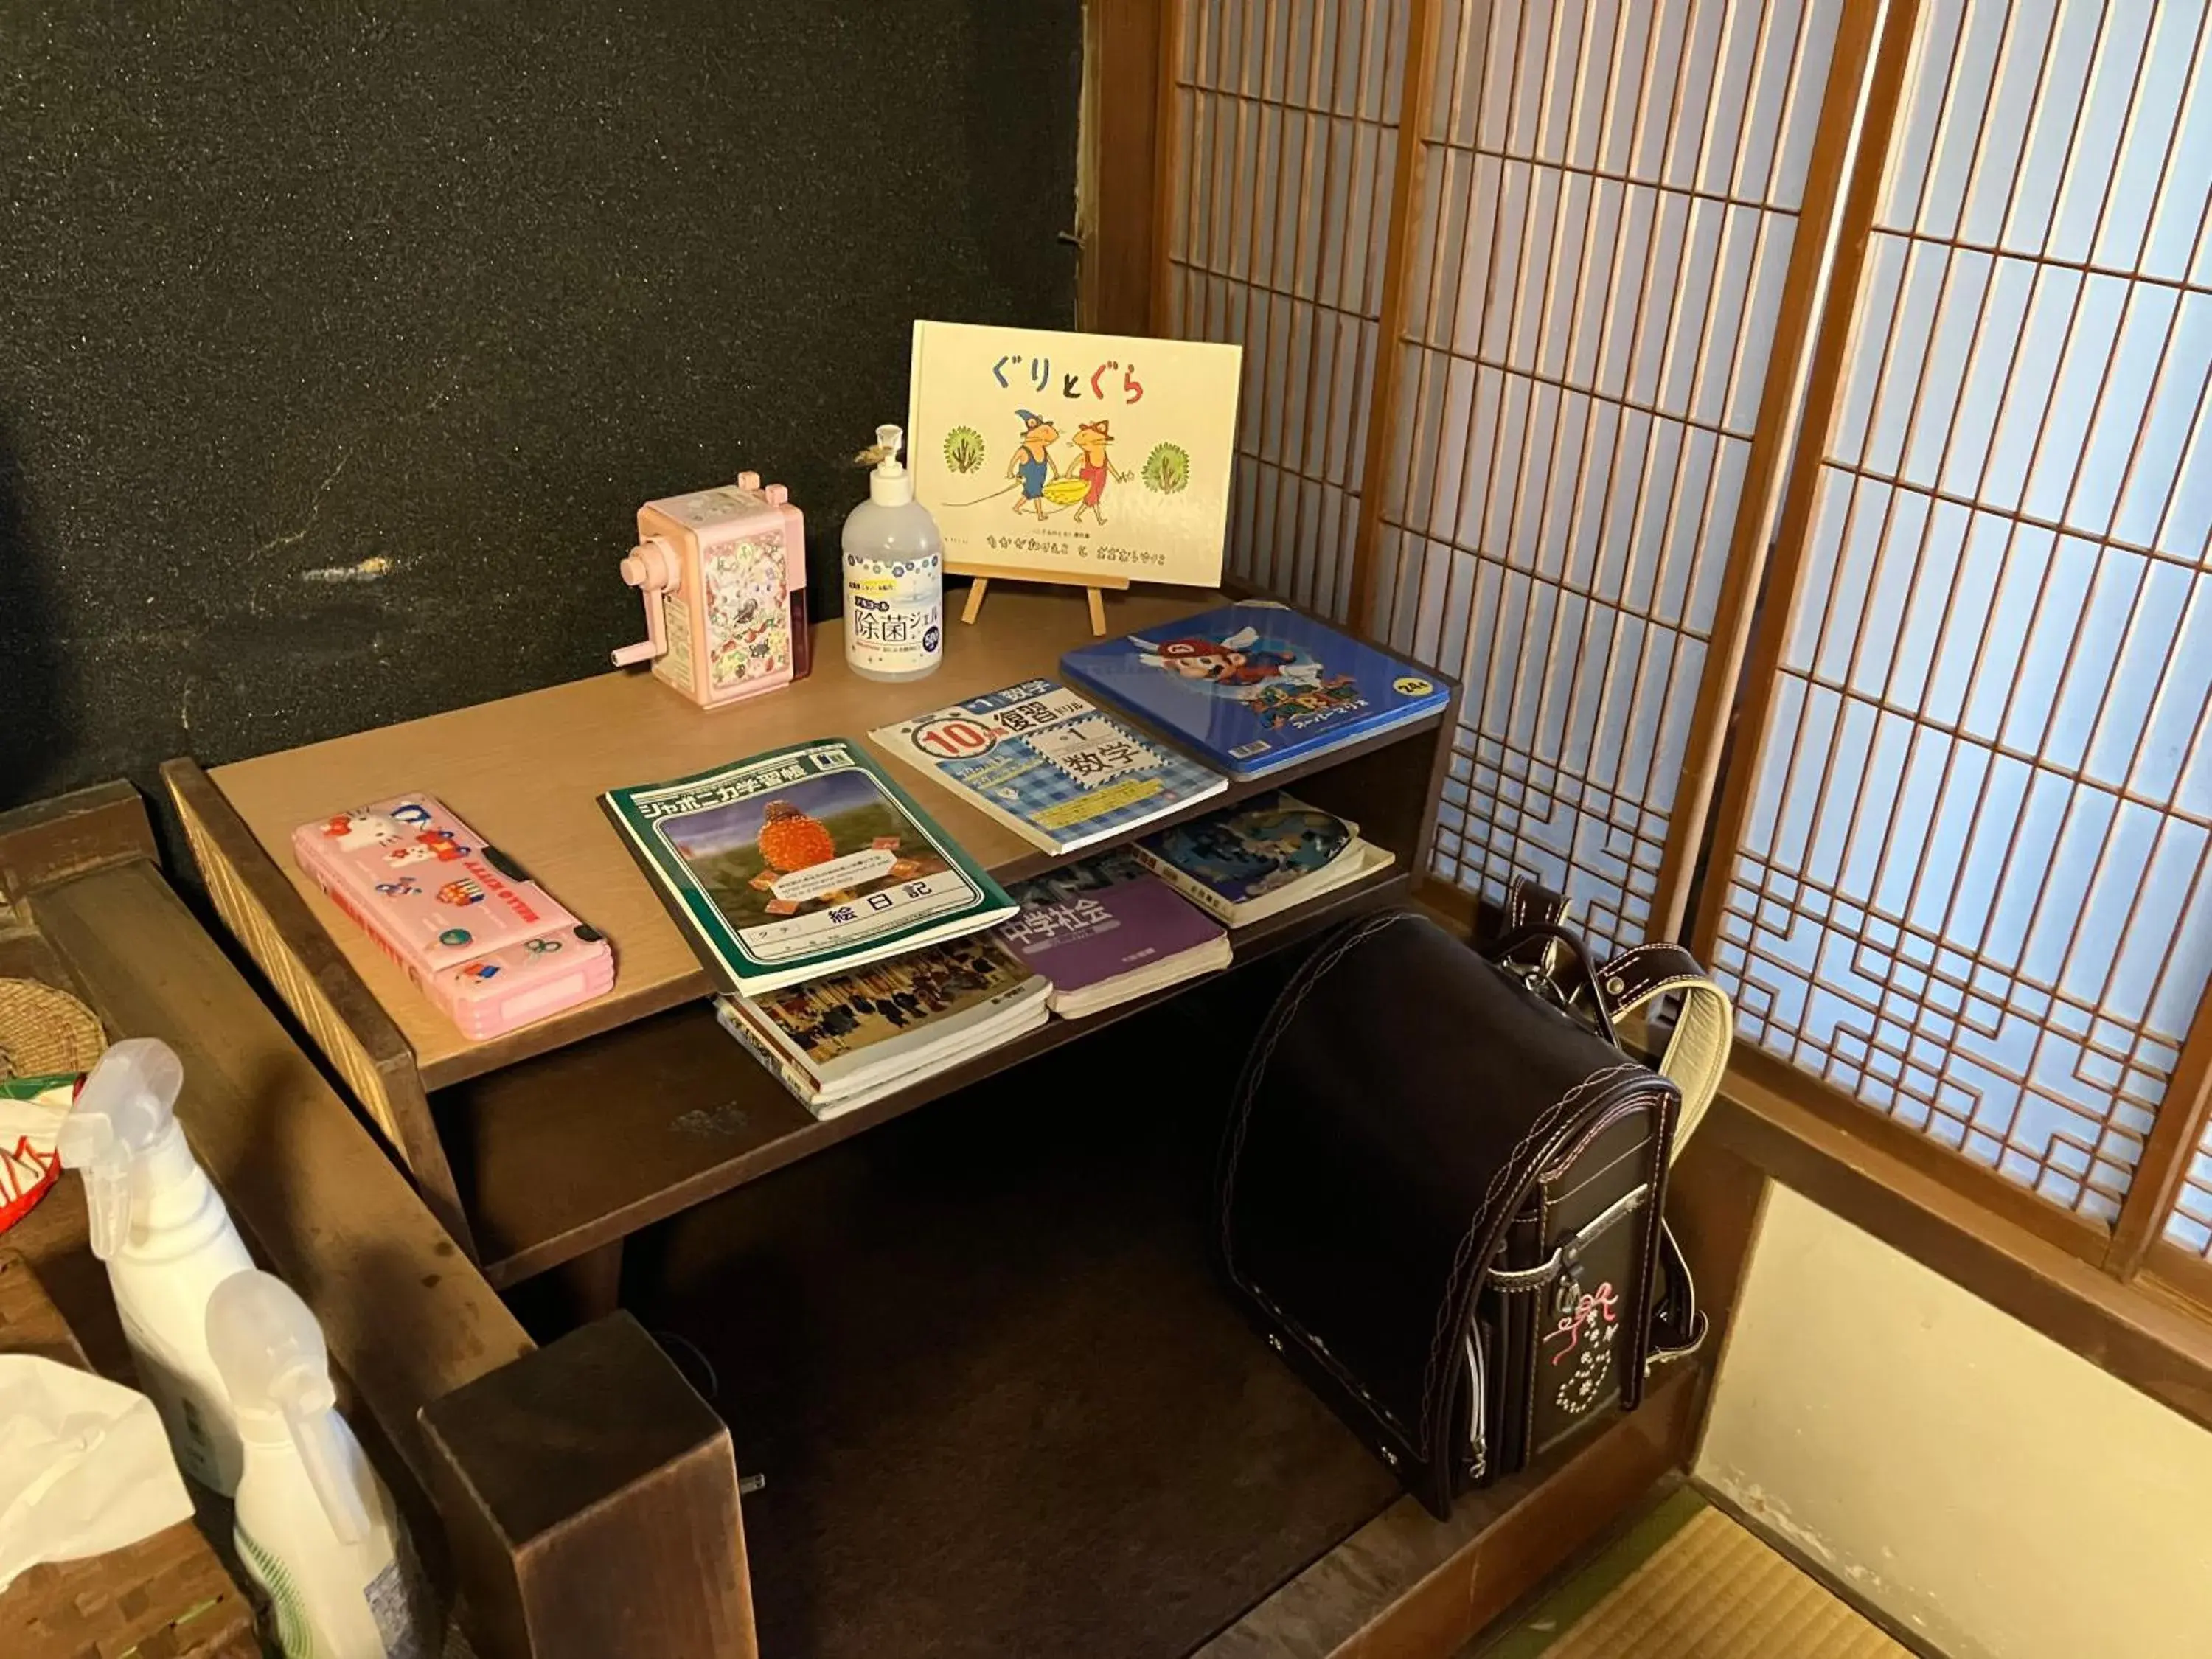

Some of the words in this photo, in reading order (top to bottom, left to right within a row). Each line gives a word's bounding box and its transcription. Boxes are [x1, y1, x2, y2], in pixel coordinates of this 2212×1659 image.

[992, 355, 1144, 405] ぐりとぐら
[855, 607, 937, 642] 除菌ジェル
[1062, 740, 1141, 777] 数学
[639, 765, 807, 819] ジャポニカ学習帳
[1004, 899, 1112, 945] 中学社会
